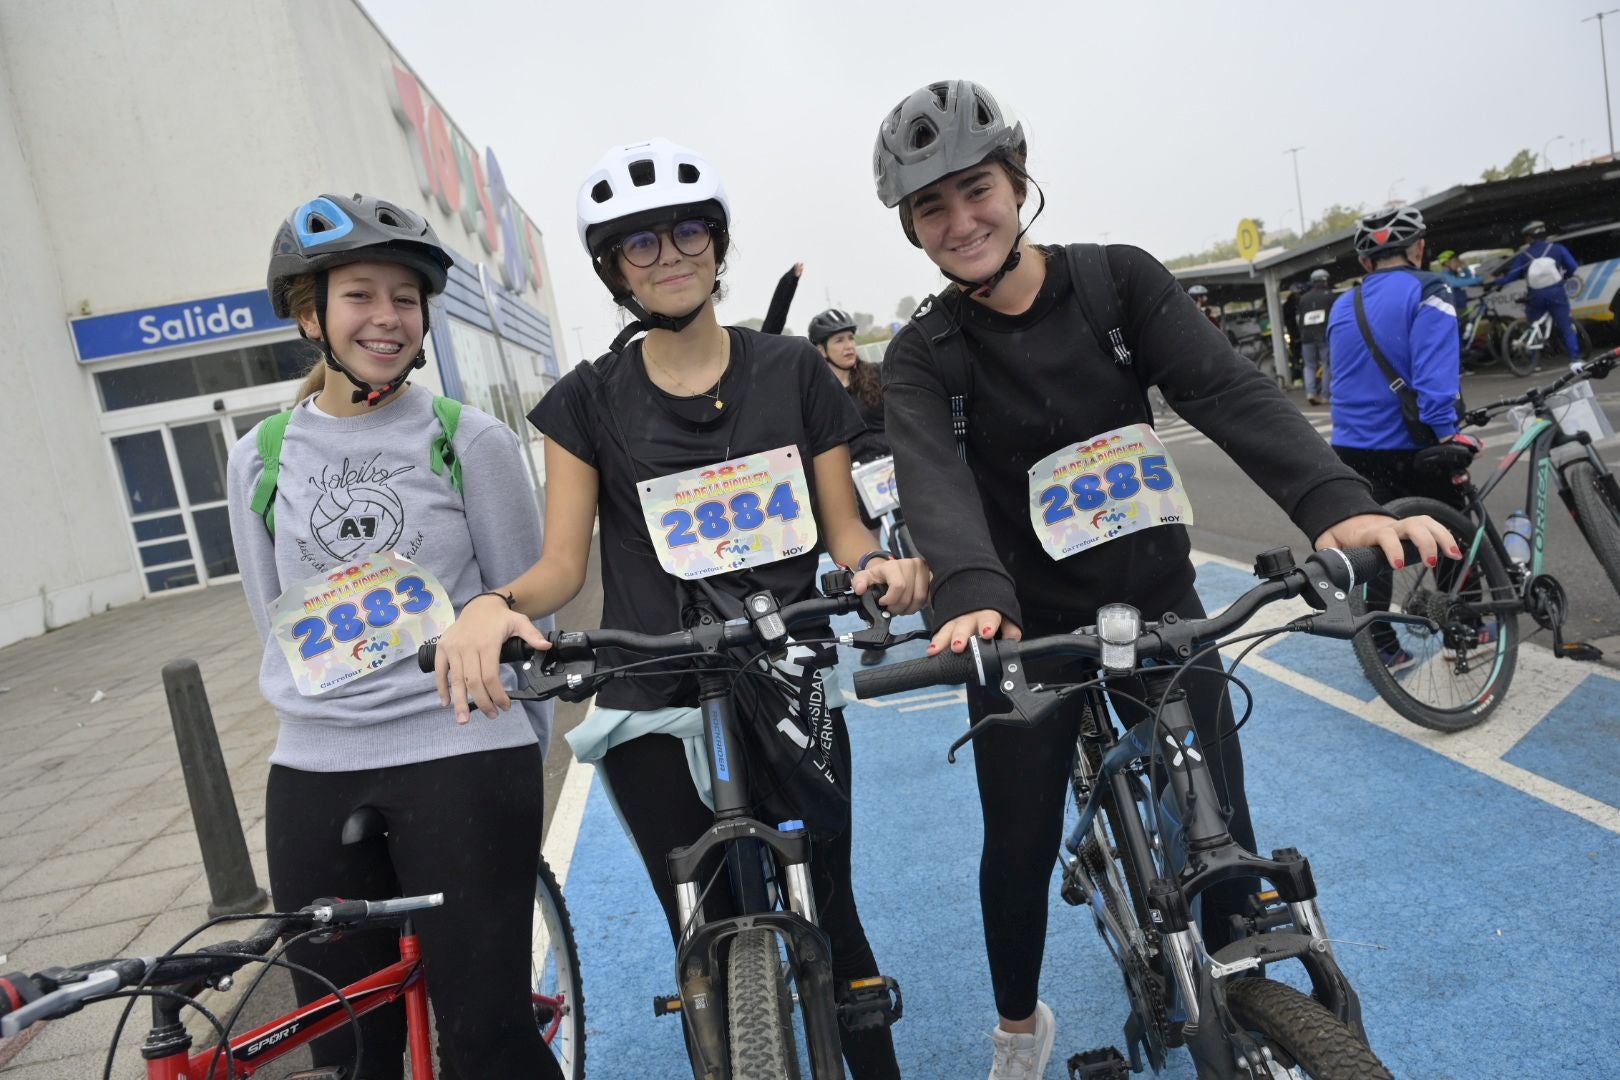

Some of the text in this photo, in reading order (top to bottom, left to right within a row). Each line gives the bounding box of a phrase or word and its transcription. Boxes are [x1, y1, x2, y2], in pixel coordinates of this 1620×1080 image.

[1241, 228, 1253, 250] D
[138, 302, 254, 345] Salida
[1039, 454, 1175, 527] 2885
[660, 480, 801, 550] 2884
[1160, 515, 1180, 523] HOY
[782, 545, 804, 557] HOY
[1061, 536, 1100, 554] Carrefour
[291, 575, 435, 661] 2883
[319, 668, 363, 690] Carrefour
[711, 710, 726, 772] ROCKRIDER
[247, 1023, 299, 1056] SPORT
